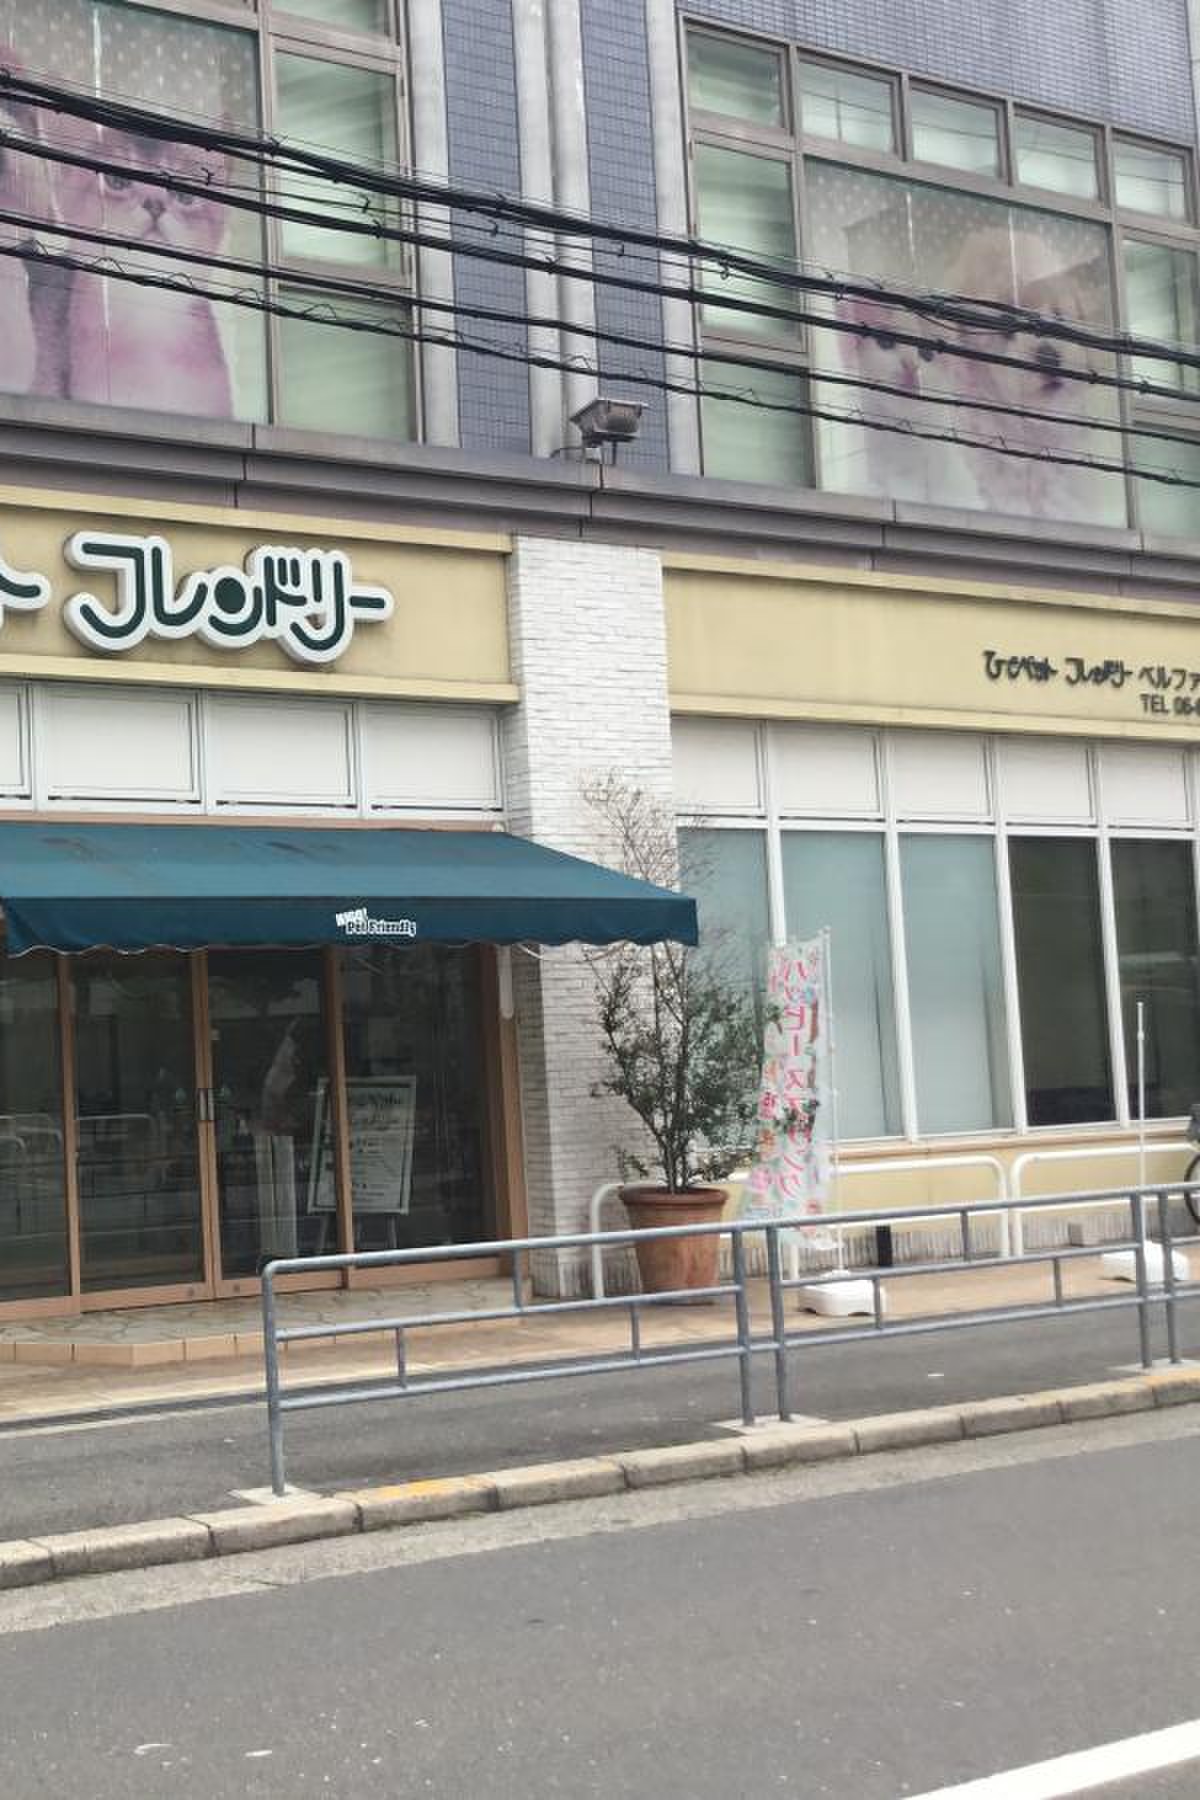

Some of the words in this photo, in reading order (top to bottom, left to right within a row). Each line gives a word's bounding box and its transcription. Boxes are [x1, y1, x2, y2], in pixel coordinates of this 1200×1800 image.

[79, 540, 387, 652] フレンドリー
[1139, 693, 1170, 714] TEL
[368, 918, 417, 937] Friendly
